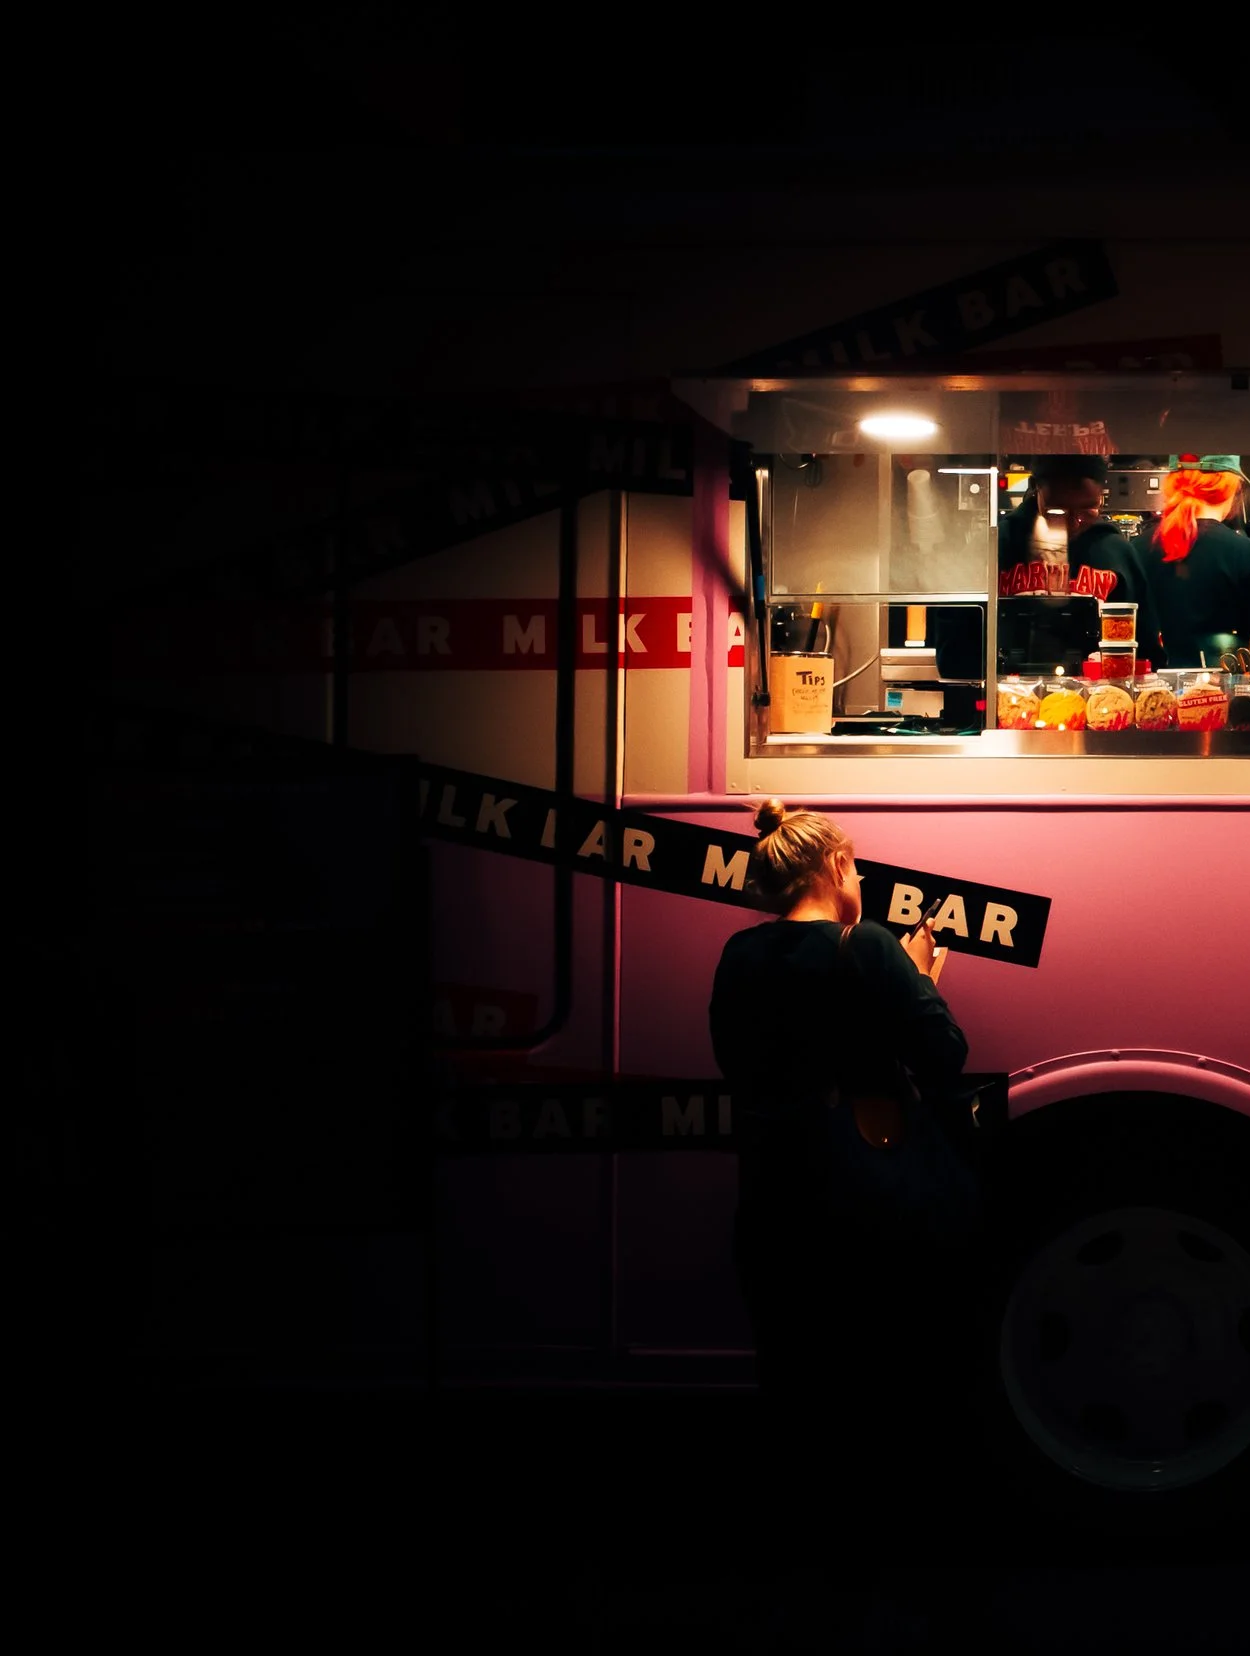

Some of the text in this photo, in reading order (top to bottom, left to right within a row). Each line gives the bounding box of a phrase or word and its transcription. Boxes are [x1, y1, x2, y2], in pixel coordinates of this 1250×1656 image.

[957, 256, 1088, 332] BAR
[502, 613, 649, 655] MLK
[886, 881, 1019, 949] BAR
